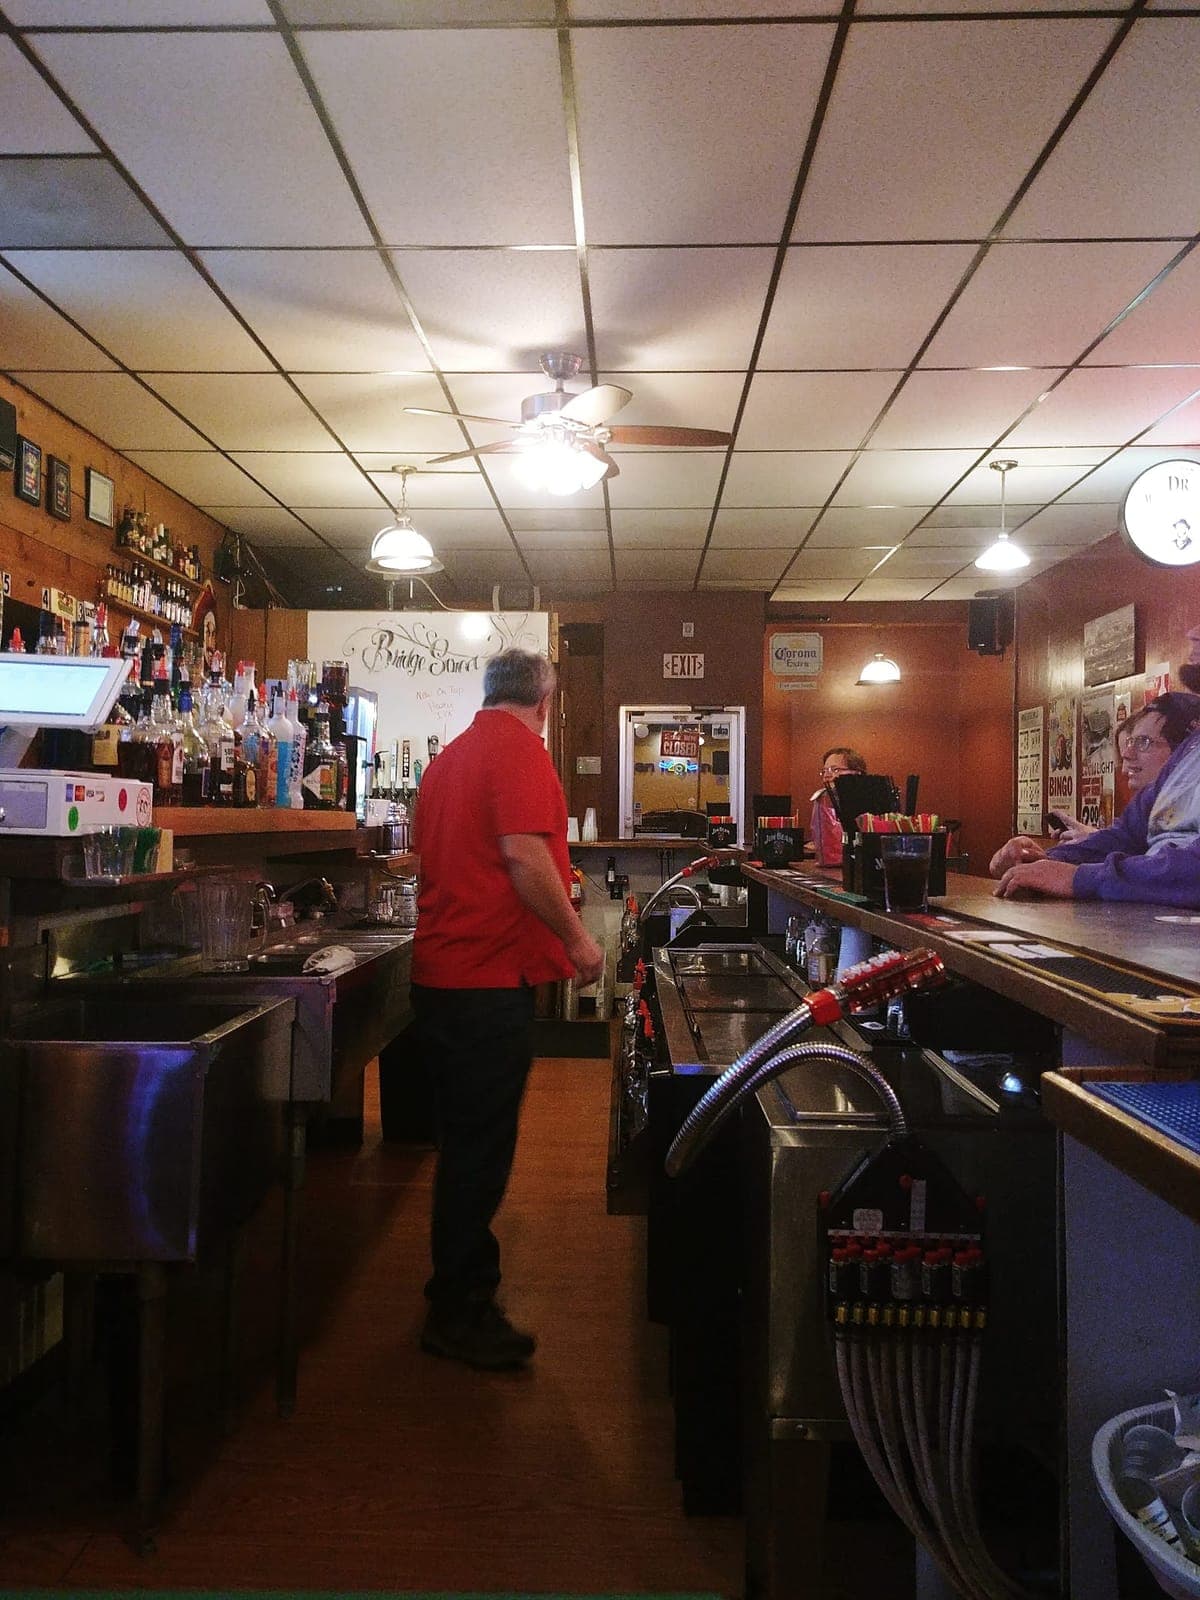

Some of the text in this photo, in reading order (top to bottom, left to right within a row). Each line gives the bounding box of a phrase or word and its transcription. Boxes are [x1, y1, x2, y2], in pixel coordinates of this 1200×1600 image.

[42, 589, 48, 609] 4
[774, 647, 817, 661] Corona
[671, 655, 698, 676] EXIT
[663, 741, 697, 756] CLOSED
[1049, 775, 1073, 797] BINGO
